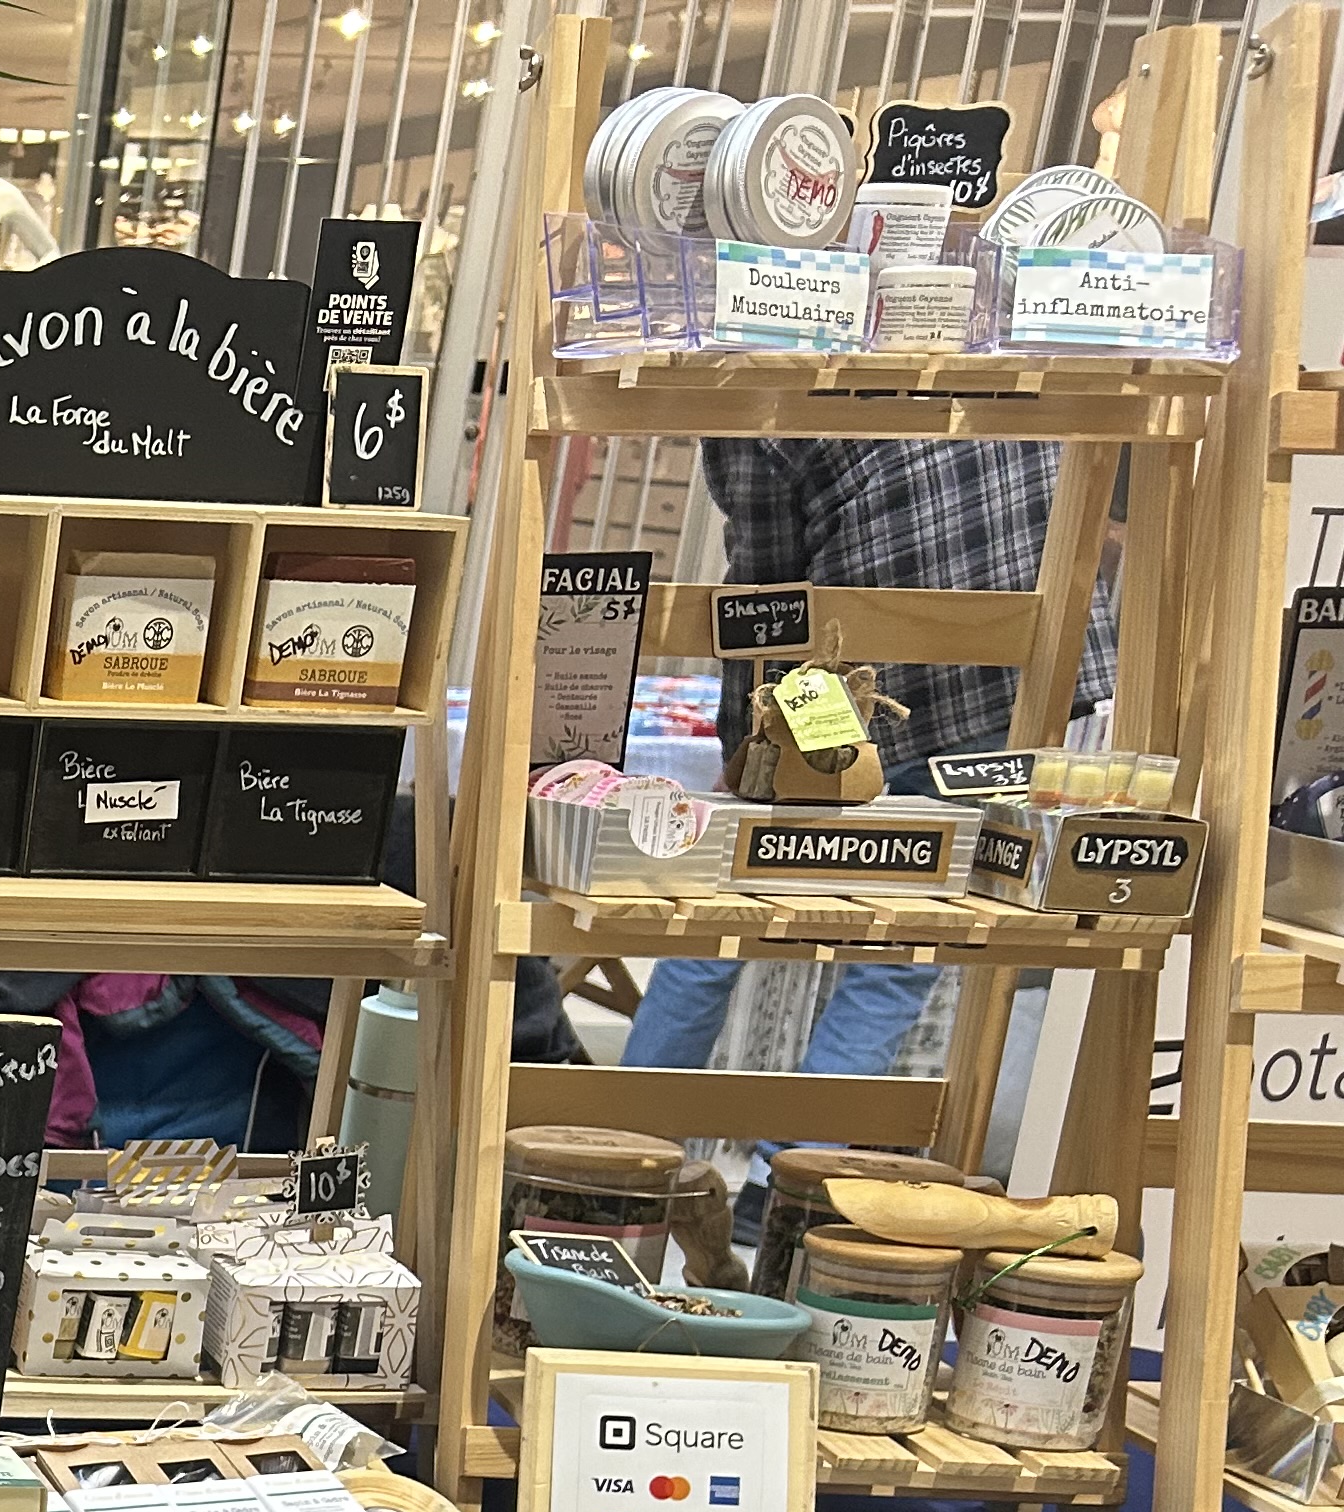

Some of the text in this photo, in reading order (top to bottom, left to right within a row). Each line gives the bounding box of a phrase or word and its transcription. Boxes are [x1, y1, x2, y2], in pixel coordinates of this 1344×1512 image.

[888, 118, 967, 161] Piqûres
[748, 268, 841, 294] Douleurs
[1079, 273, 1151, 291] Anti-
[328, 294, 388, 310] POINTS
[732, 294, 855, 326] Musculaires
[1017, 298, 1206, 325] inflammatoire
[318, 309, 393, 326] DE VENTE
[122, 287, 156, 345] à
[169, 298, 199, 362] la
[208, 323, 304, 445] bière
[9, 395, 111, 445] La Forge
[94, 425, 191, 459] du Malt
[542, 568, 641, 592] FACIAL
[103, 656, 168, 670] SABROUE
[543, 646, 617, 657] Pour le visage
[299, 669, 368, 684] SABROUE
[59, 751, 116, 779] Bière
[240, 761, 289, 790] Bière
[261, 797, 363, 835] La Tignasse
[757, 834, 934, 866] SHAMPOING
[1077, 836, 1182, 867] LYPSYL
[1108, 878, 1131, 903] 3
[865, 1352, 894, 1365] bain
[645, 1422, 744, 1453] Square
[592, 1477, 634, 1493] VISA
